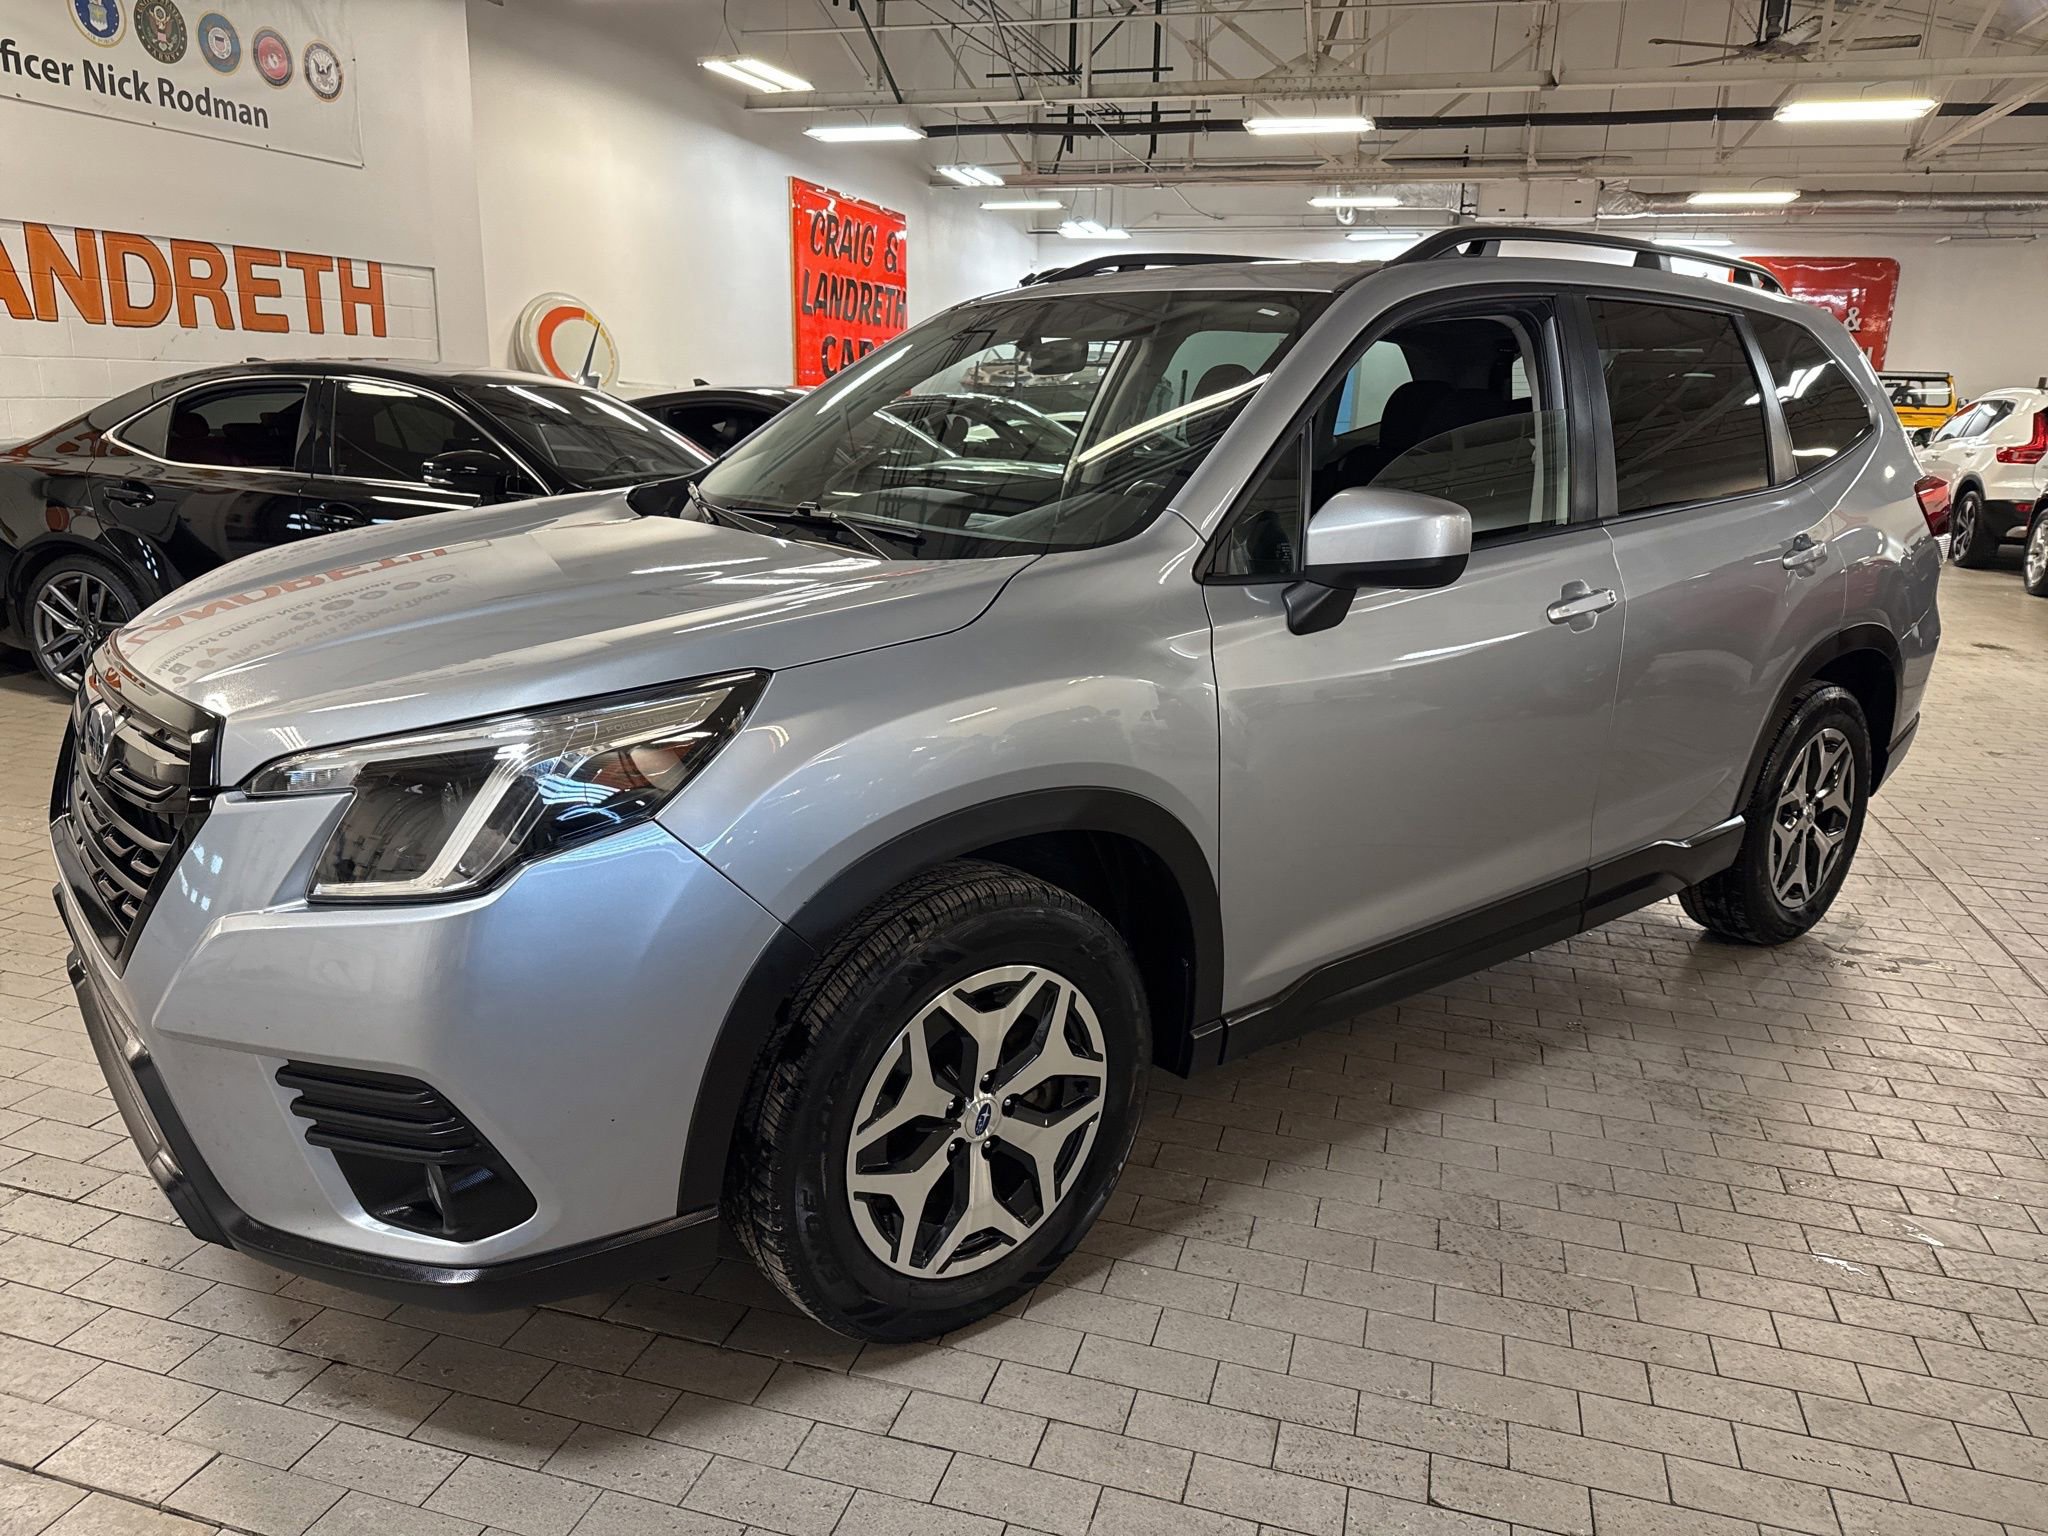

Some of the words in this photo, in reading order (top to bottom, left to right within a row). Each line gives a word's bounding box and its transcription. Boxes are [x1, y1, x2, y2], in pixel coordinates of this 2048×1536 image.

[151, 50, 176, 61] ARMY
[83, 59, 152, 105] Nick
[158, 78, 270, 130] Rodman
[809, 210, 875, 268] CRAIG
[884, 231, 899, 273] &
[801, 268, 907, 330] LANDRETH
[1843, 306, 1862, 332] &
